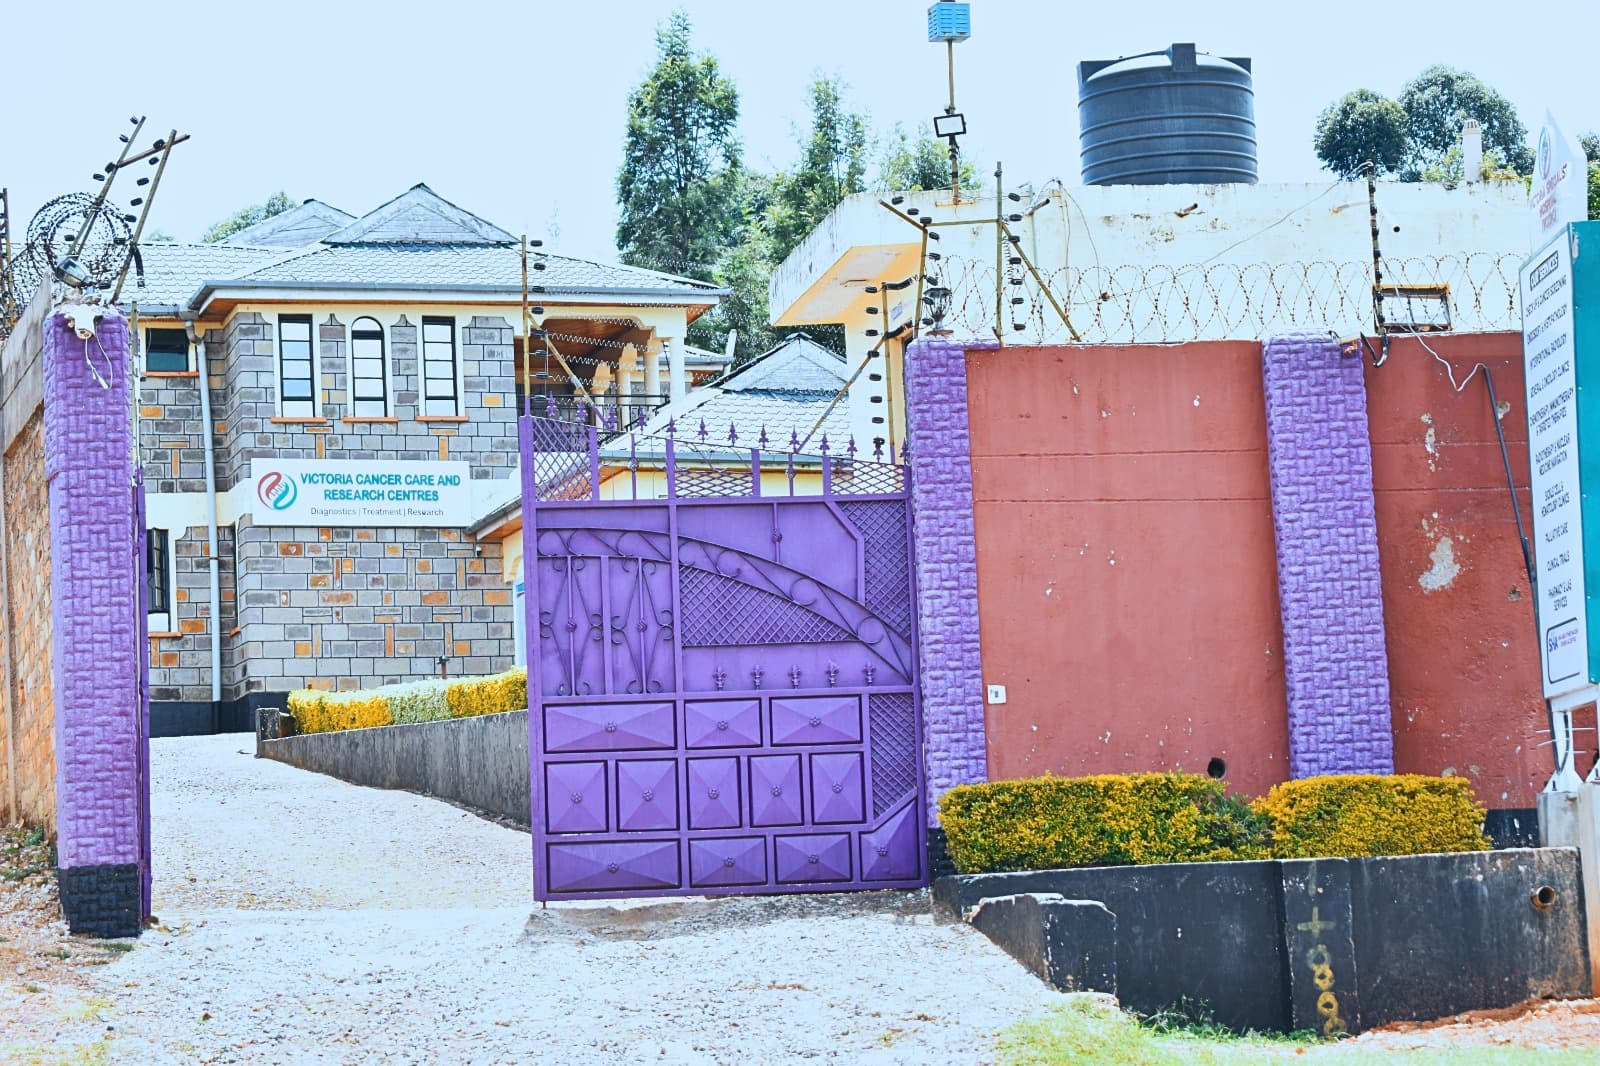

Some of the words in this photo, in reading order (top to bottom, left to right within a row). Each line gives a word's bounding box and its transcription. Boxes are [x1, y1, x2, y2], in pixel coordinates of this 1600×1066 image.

[301, 473, 352, 485] VICTORIA
[356, 473, 402, 486] CANCER
[404, 474, 435, 486] CARE
[438, 475, 460, 486] AND
[324, 489, 385, 501] RESEARCH
[387, 489, 439, 501] CENTRES
[310, 507, 356, 517] Diagnostics
[362, 507, 402, 516] Treatment
[407, 508, 444, 516] Research
